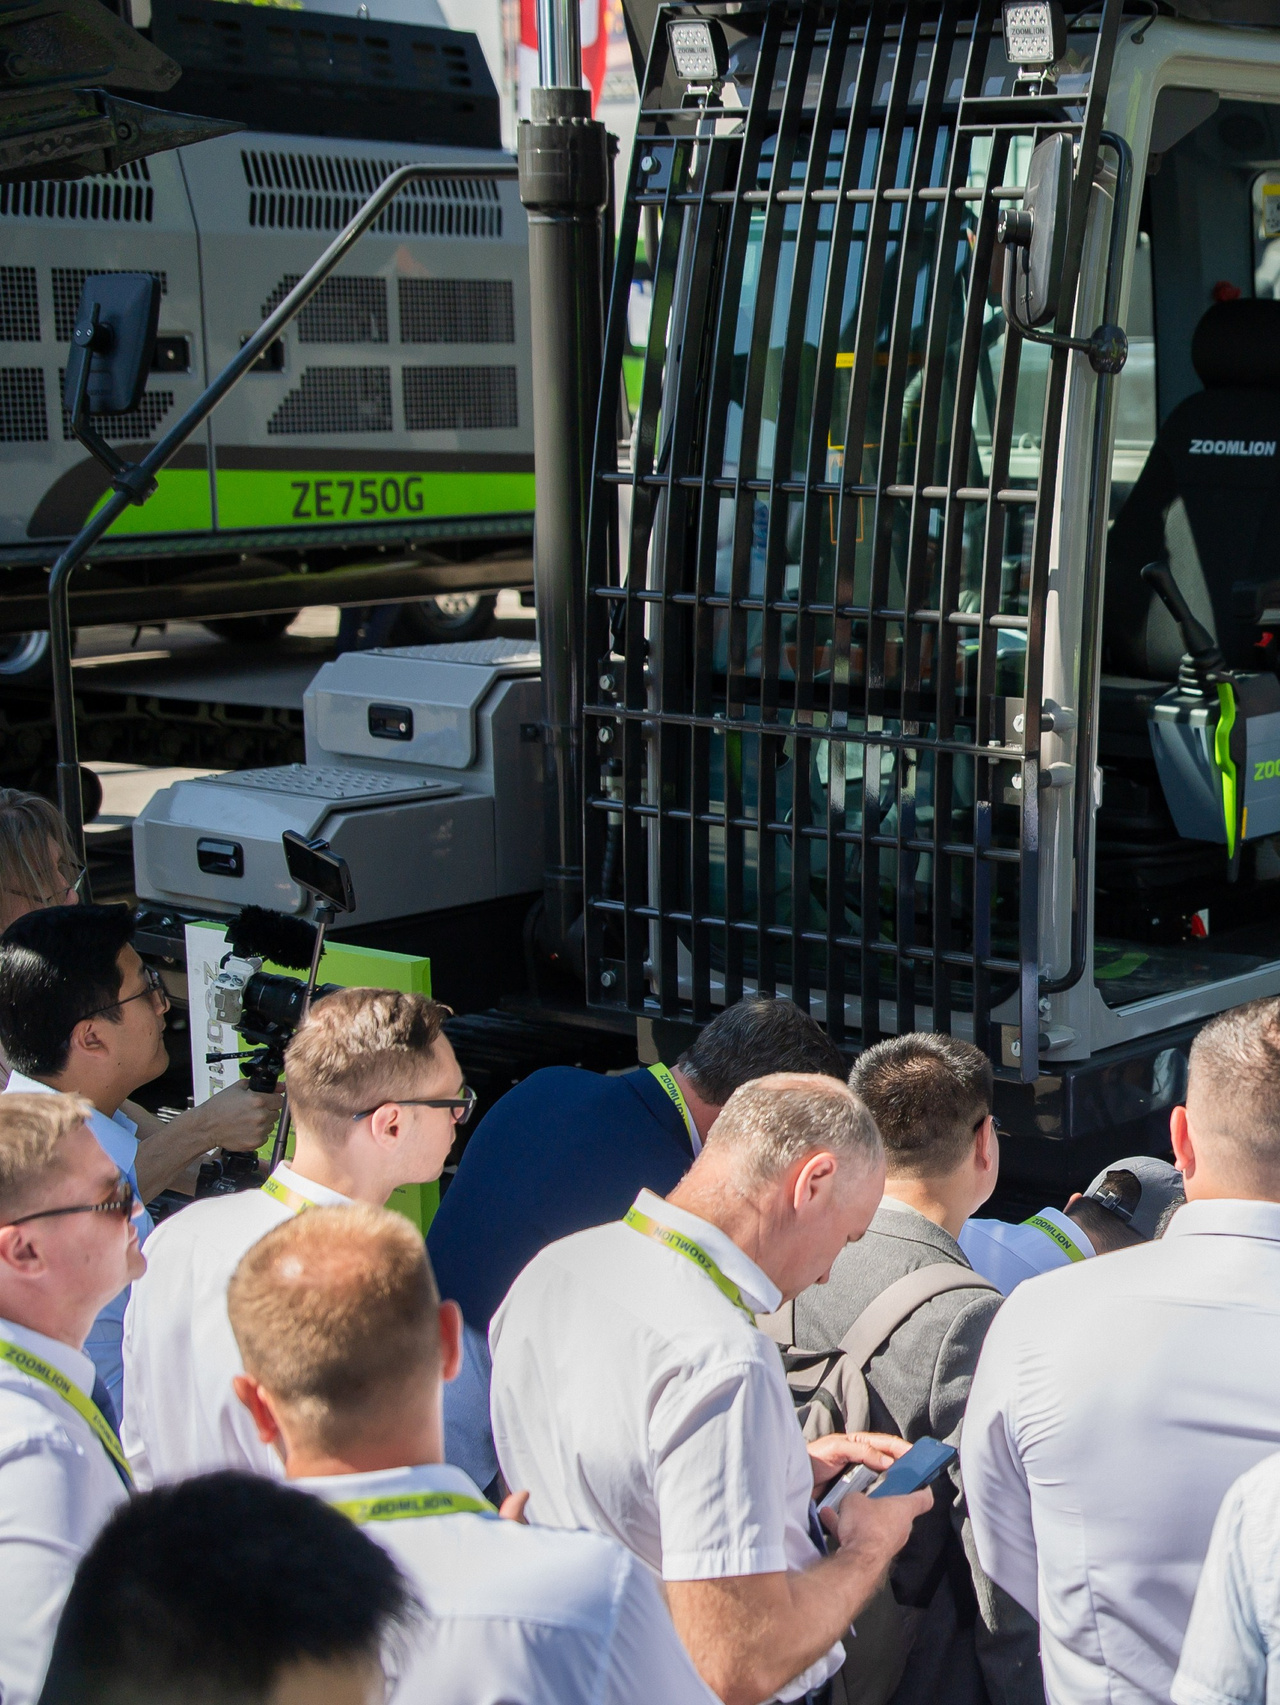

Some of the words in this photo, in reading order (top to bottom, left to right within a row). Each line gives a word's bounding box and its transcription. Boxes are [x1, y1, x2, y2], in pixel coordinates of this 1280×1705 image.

[1011, 27, 1045, 36] ZOOMLION
[1189, 439, 1277, 456] ZOOMLION
[291, 476, 424, 518] ZE750G
[654, 1226, 713, 1270] ZOOMLION
[1031, 1218, 1072, 1249] ZOOMLION
[5, 1346, 72, 1393] ZOOMLION
